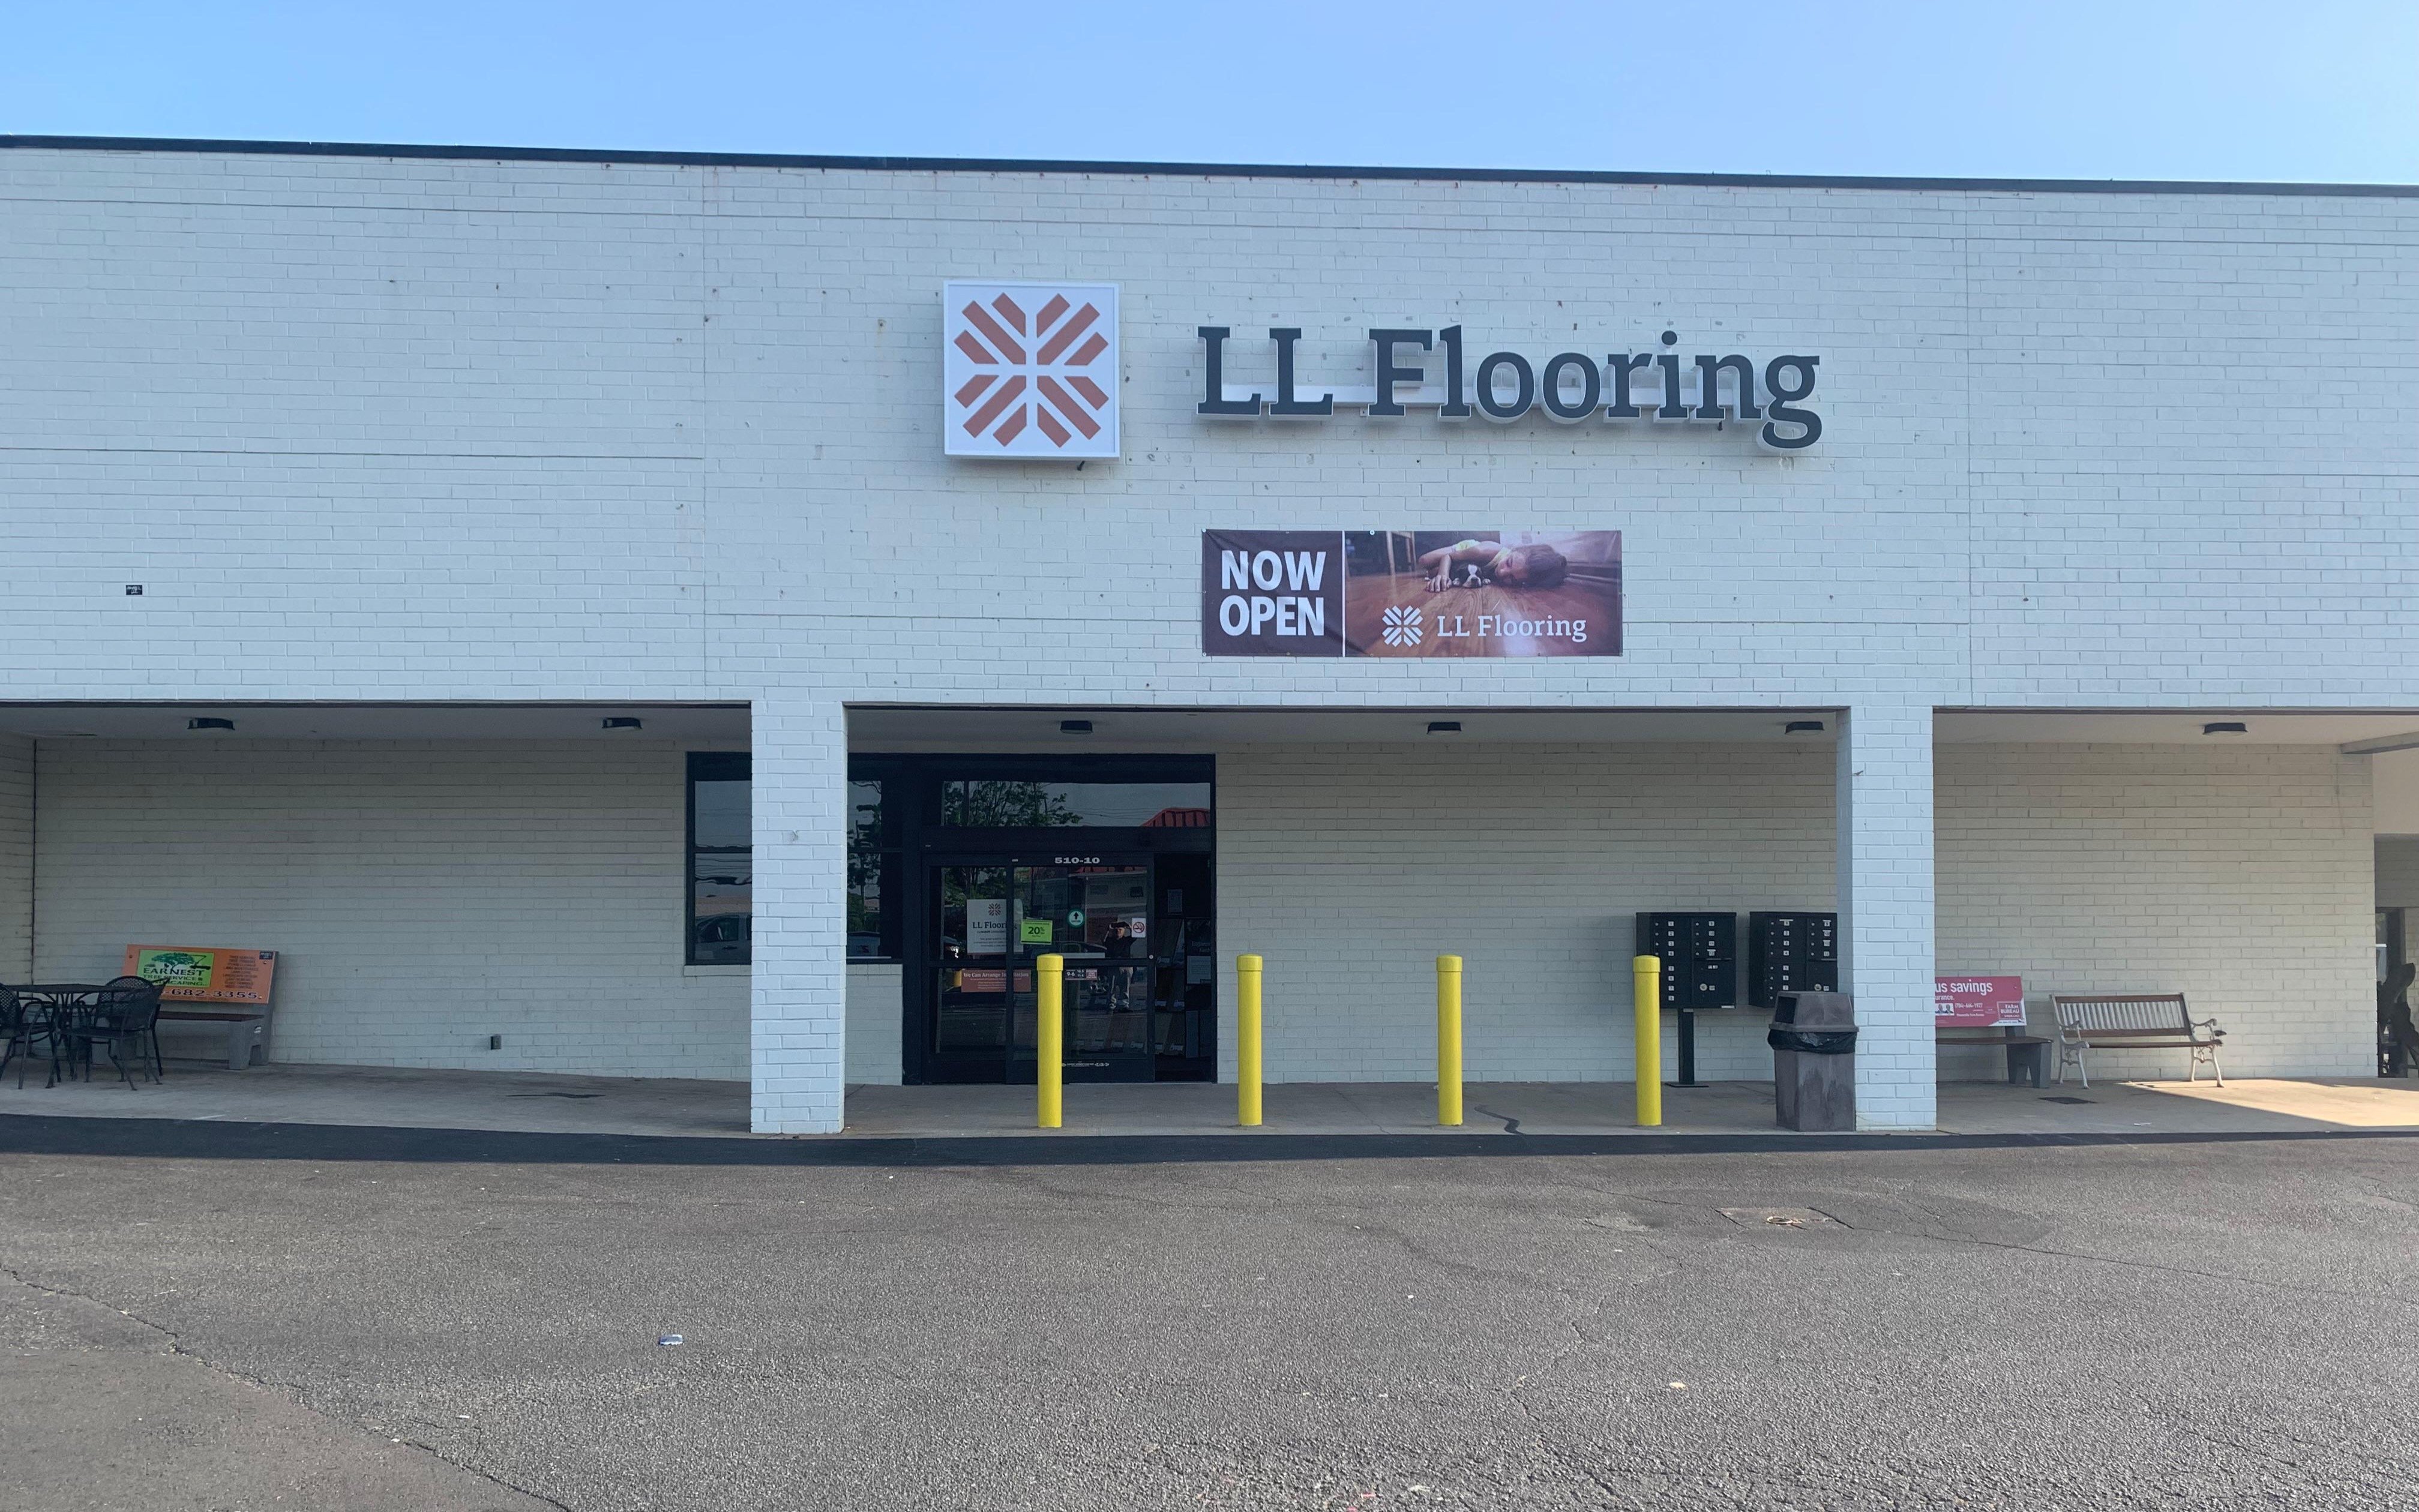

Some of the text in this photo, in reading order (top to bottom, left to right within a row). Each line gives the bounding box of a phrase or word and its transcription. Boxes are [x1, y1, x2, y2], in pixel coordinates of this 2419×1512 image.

[1197, 325, 1822, 448] LL Flooring
[1222, 550, 1326, 590] NOW
[1219, 595, 1324, 636] OPEN
[1437, 614, 1587, 642] LL Flooring
[985, 921, 1018, 929] Floorig
[143, 967, 204, 976] EARNEST
[1935, 980, 1993, 995] us savings
